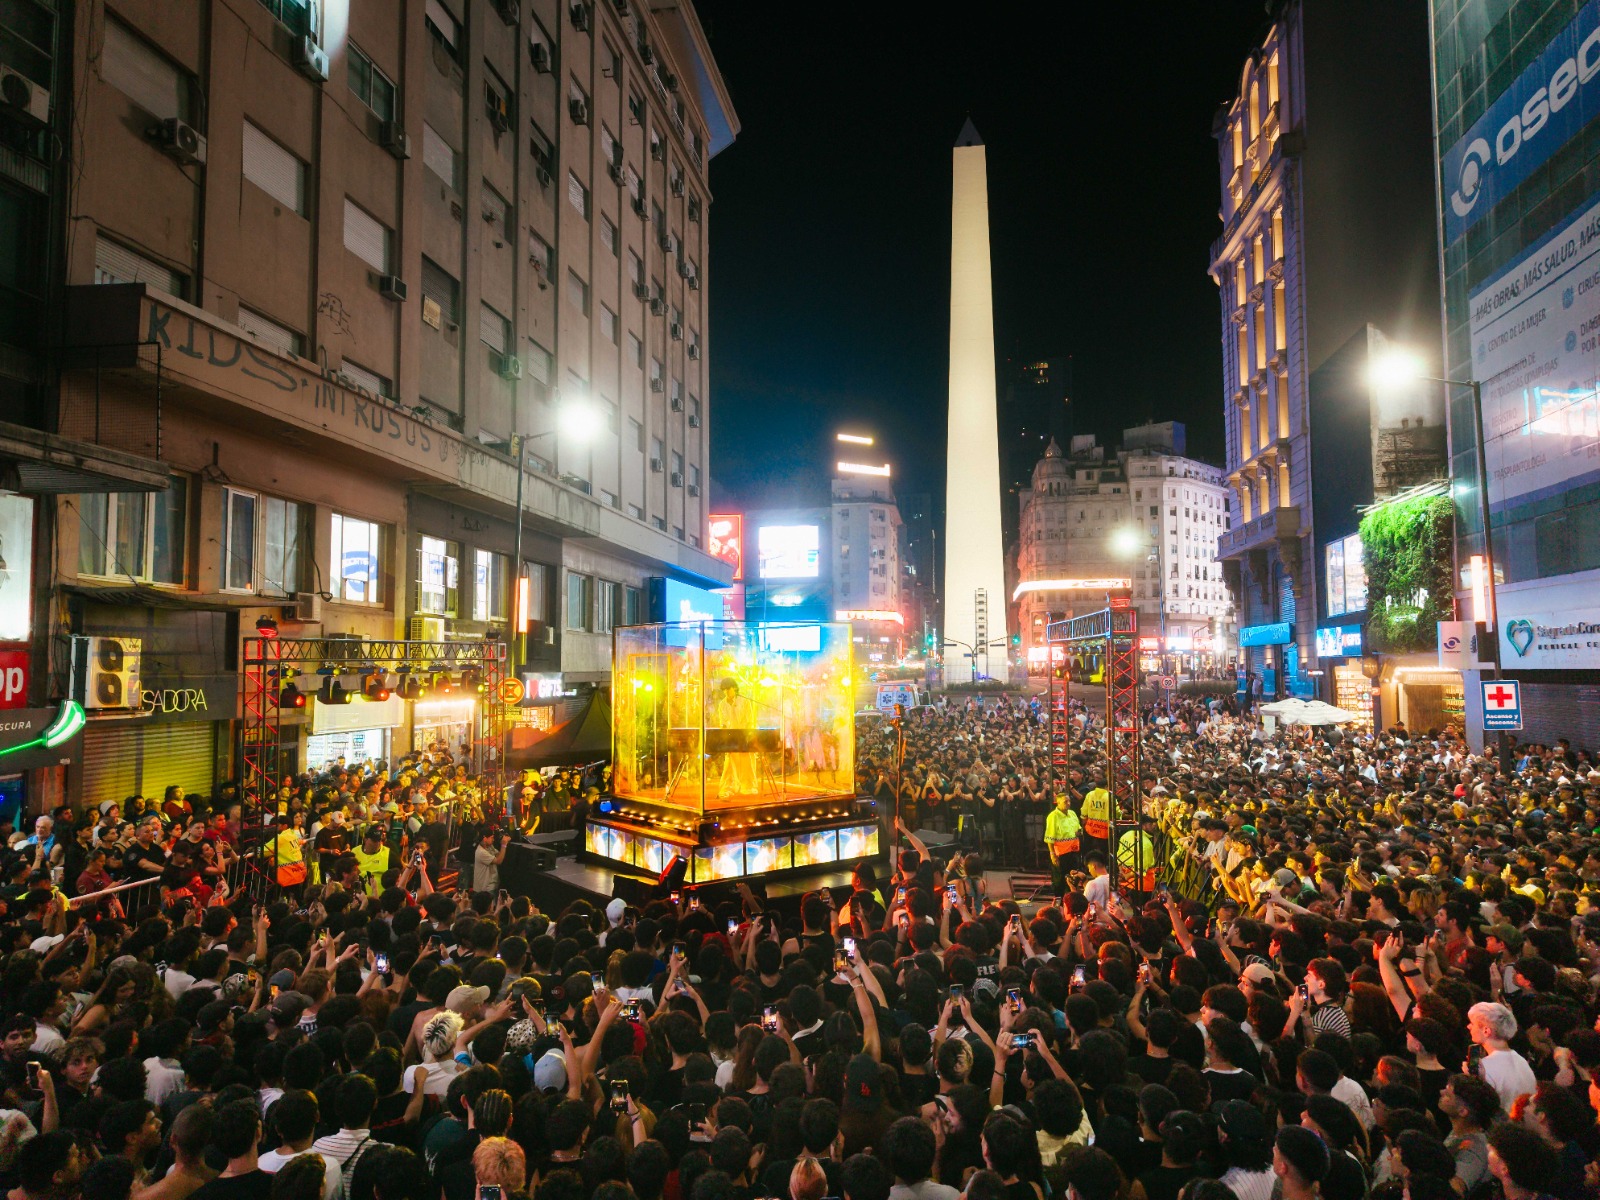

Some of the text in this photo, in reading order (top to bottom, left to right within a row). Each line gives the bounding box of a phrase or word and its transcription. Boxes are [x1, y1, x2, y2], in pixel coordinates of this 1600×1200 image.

[1476, 297, 1492, 322] MÁS
[1493, 279, 1520, 309] OBRAS,
[1523, 261, 1542, 290] MÁS
[1544, 240, 1577, 275] SALUD,
[148, 303, 298, 392] KIDS
[1488, 308, 1546, 352] CENTRO DE LA MUJER
[538, 679, 562, 698] GIFTS
